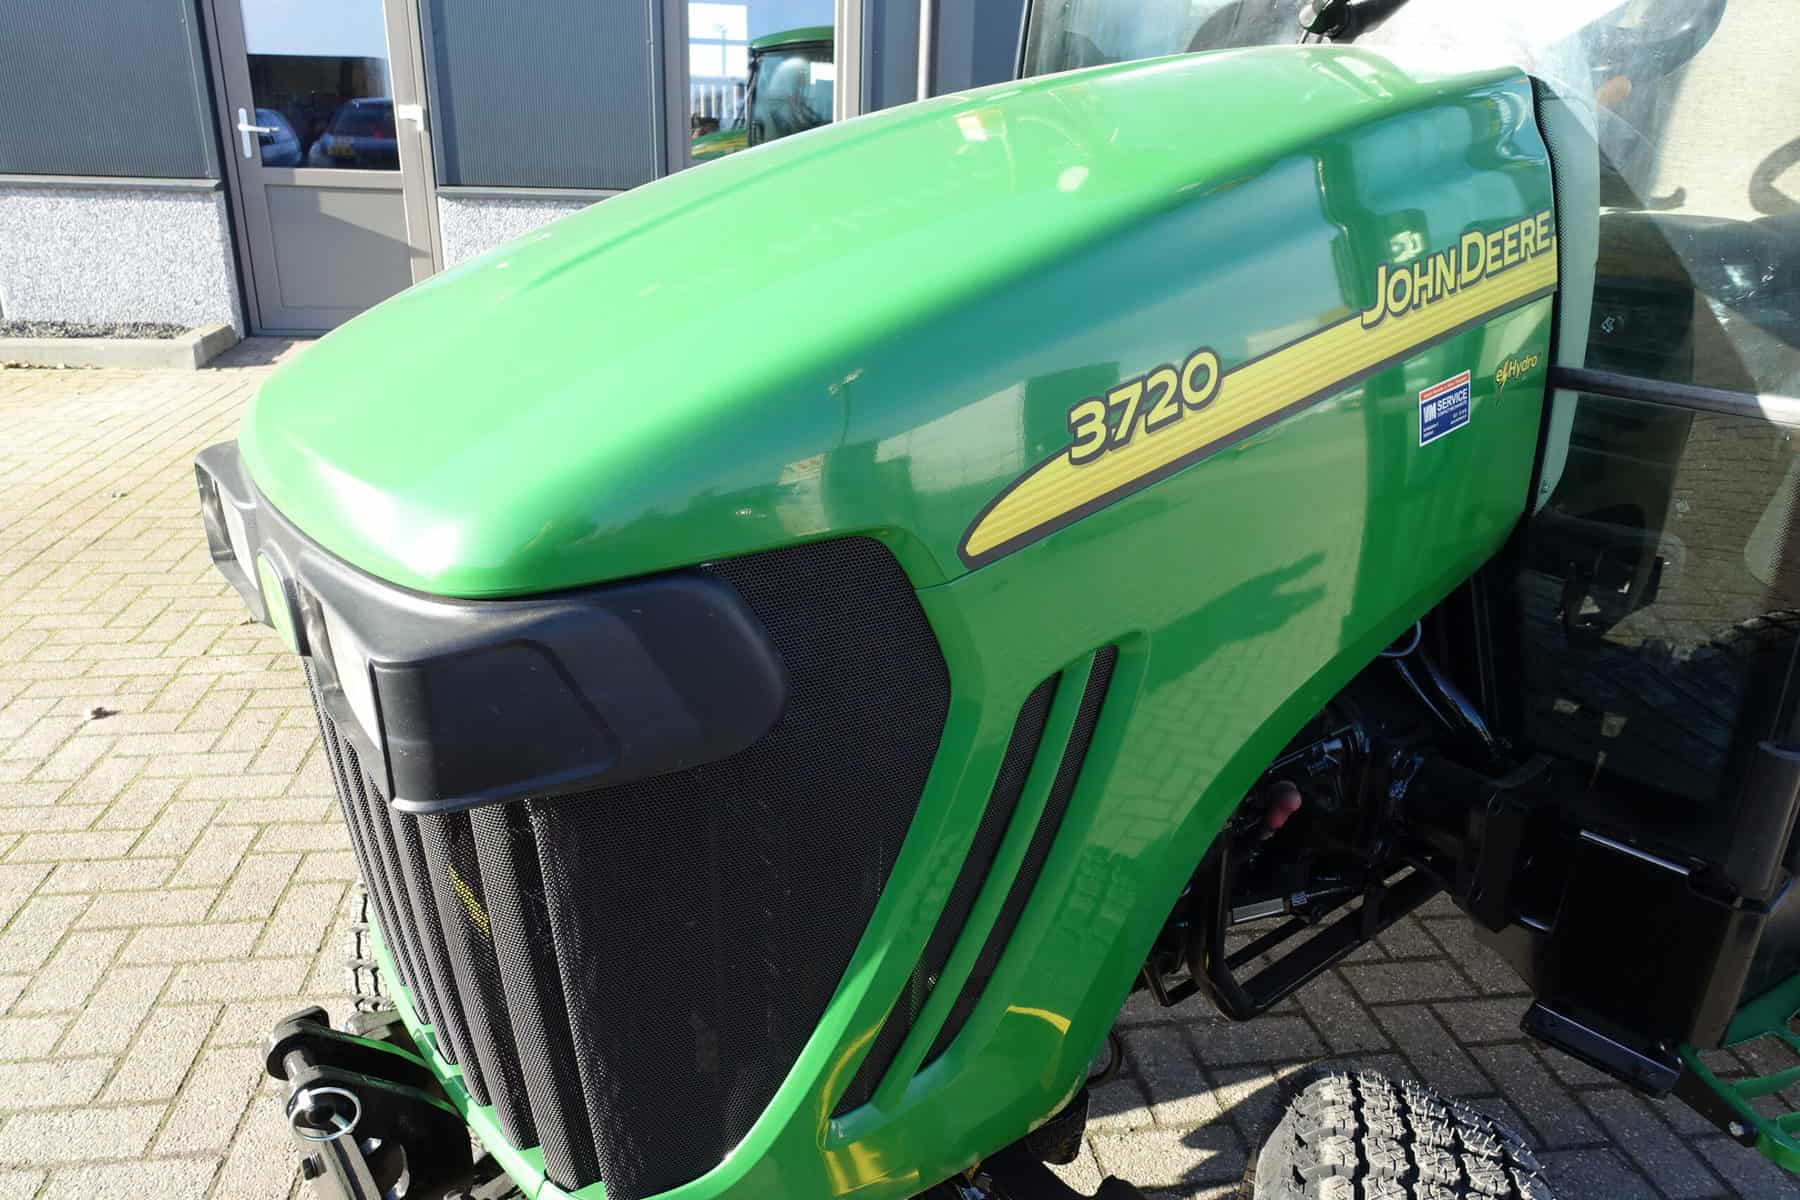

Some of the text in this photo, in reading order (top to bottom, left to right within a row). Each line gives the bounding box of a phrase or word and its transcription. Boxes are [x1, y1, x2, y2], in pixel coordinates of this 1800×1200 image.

[1361, 209, 1553, 328] JOHN DEERE
[1068, 348, 1221, 464] 3720
[1437, 388, 1468, 412] SERVICE
